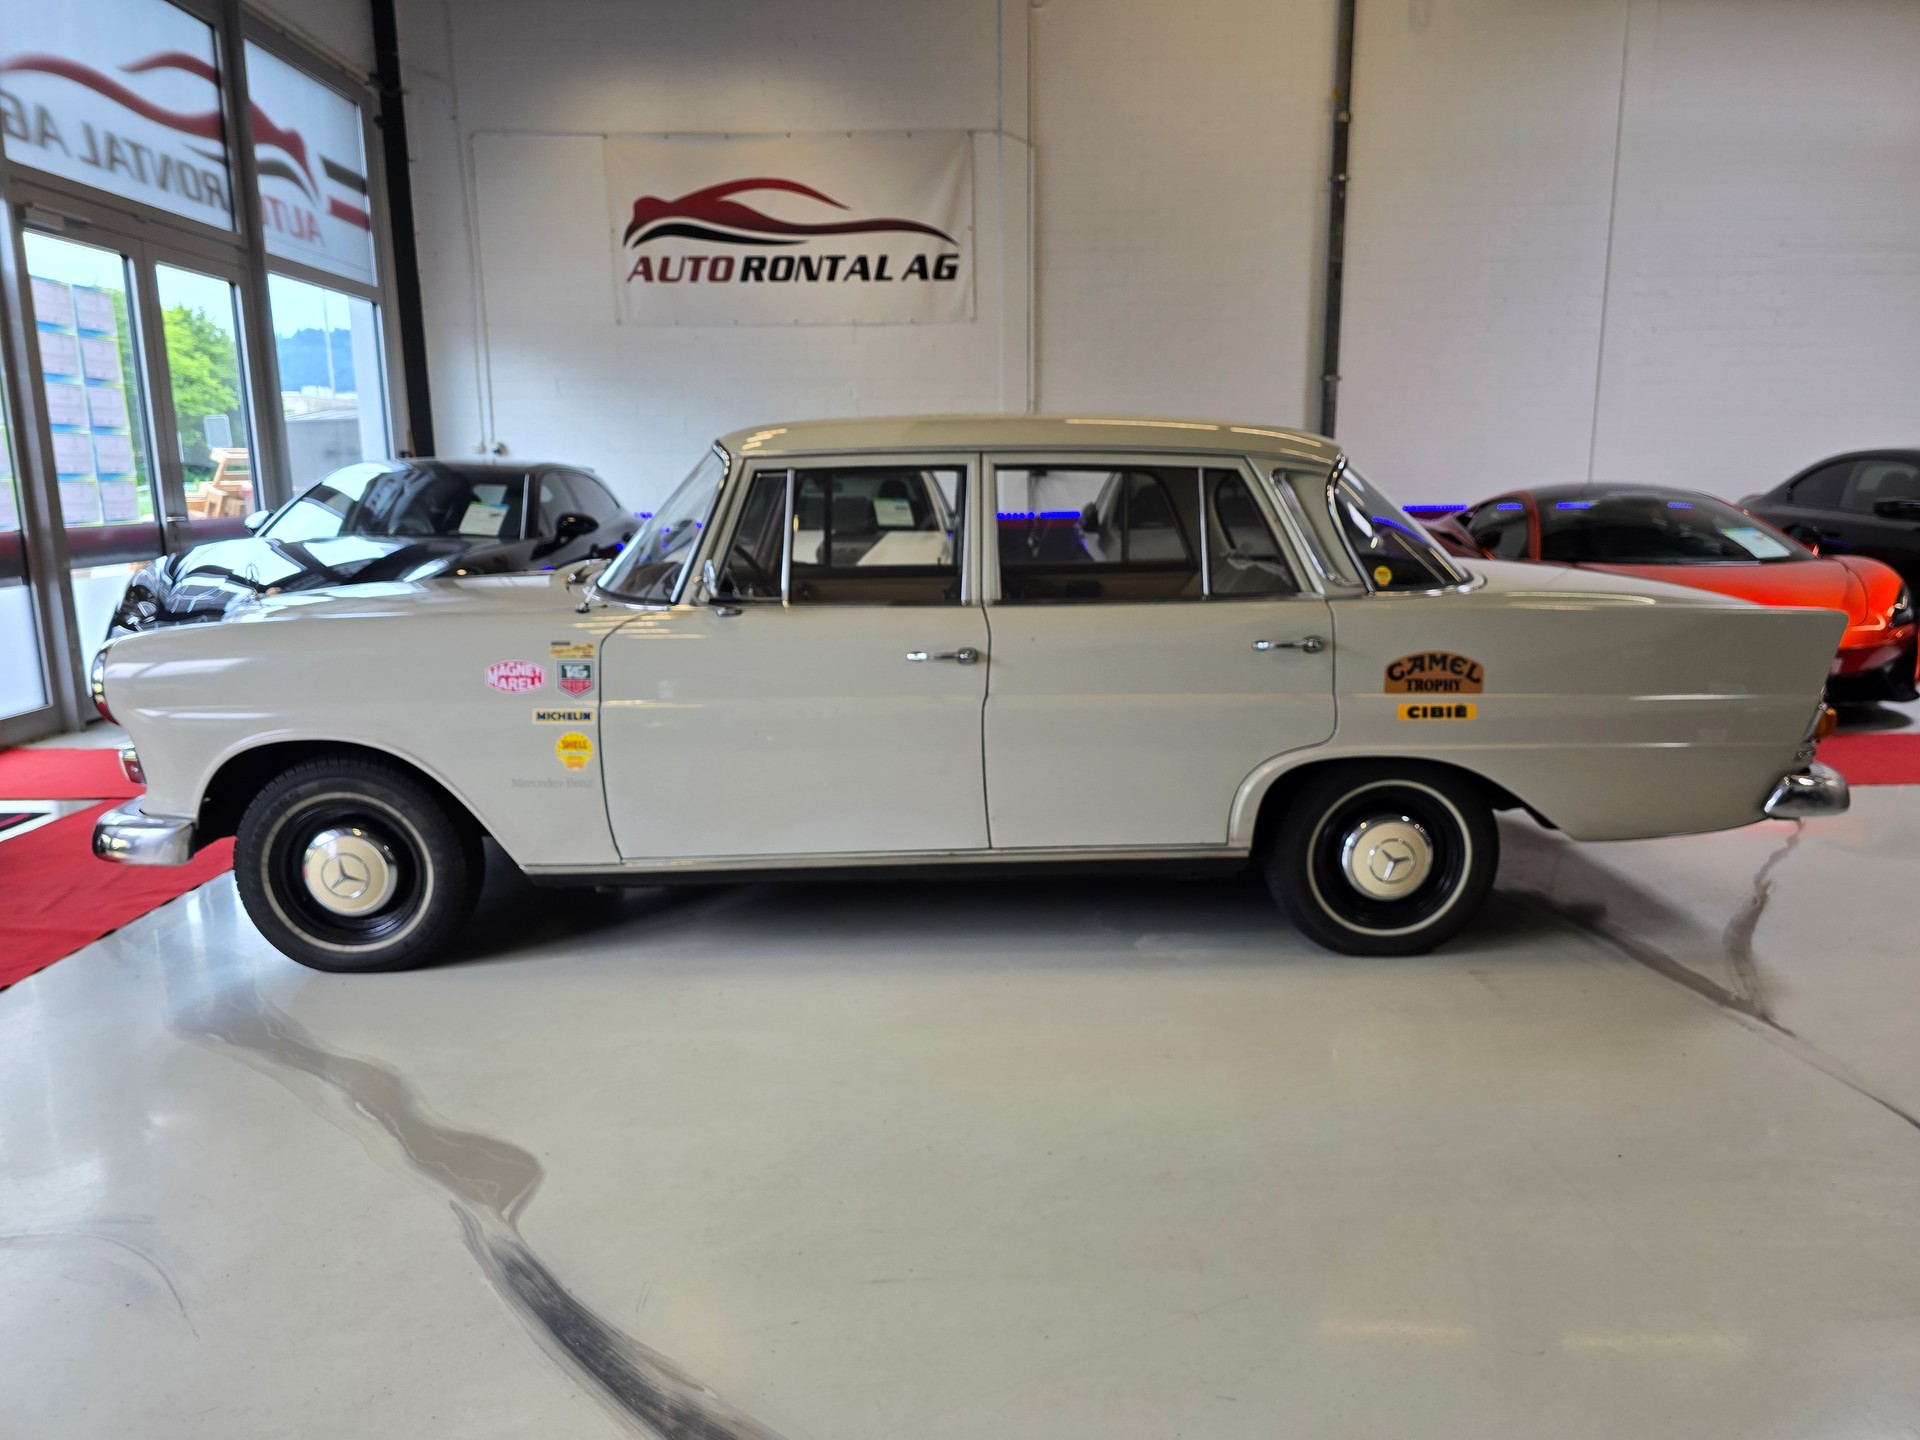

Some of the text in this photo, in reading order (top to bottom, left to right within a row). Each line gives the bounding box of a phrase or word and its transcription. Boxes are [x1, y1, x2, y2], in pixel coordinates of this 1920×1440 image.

[627, 253, 961, 284] AUTO RONTAL AG
[563, 665, 589, 679] TAG
[1387, 654, 1482, 684] CAMEL
[1406, 679, 1461, 692] TROPHY
[537, 711, 591, 721] MICHELIN
